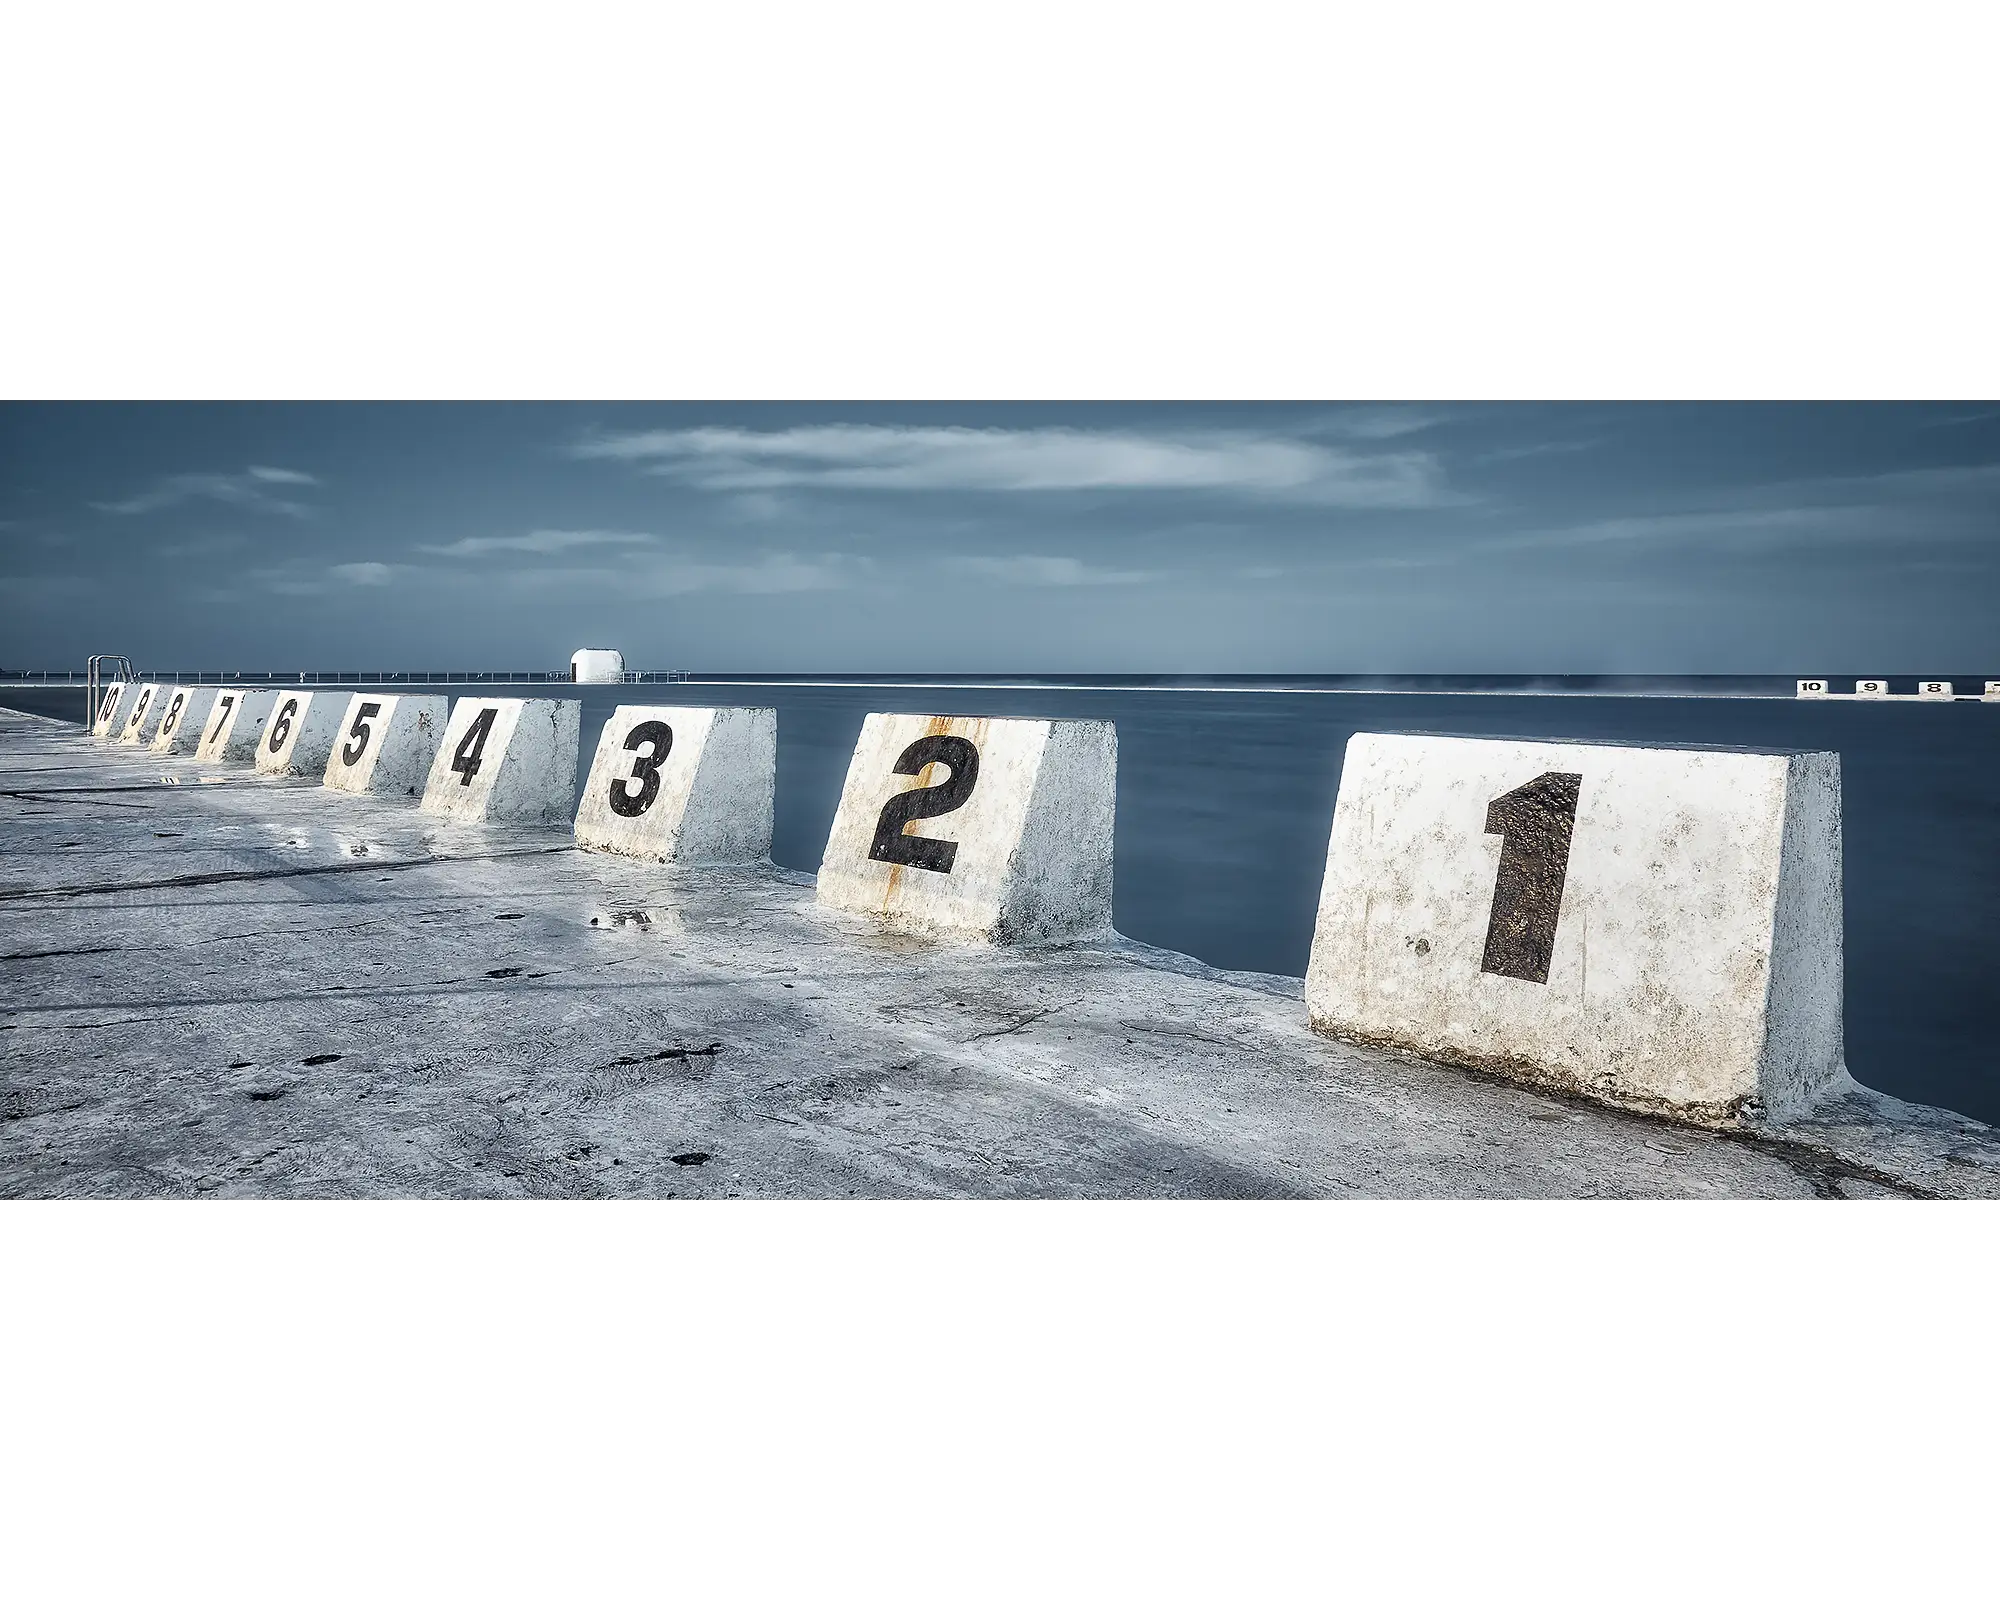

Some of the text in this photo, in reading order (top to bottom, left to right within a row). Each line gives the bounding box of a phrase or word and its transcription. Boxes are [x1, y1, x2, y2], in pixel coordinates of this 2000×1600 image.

[100, 686, 119, 721] 10
[131, 689, 151, 727] 9
[1801, 682, 1822, 691] 10
[1863, 682, 1878, 692] 9
[1927, 683, 1942, 693] 8
[163, 693, 184, 735] 8
[209, 696, 235, 744] 7
[269, 698, 298, 754] 6
[342, 702, 382, 767] 5
[450, 708, 499, 788] 4
[609, 720, 673, 818] 3
[868, 734, 980, 875] 2
[1480, 771, 1583, 986] 1
